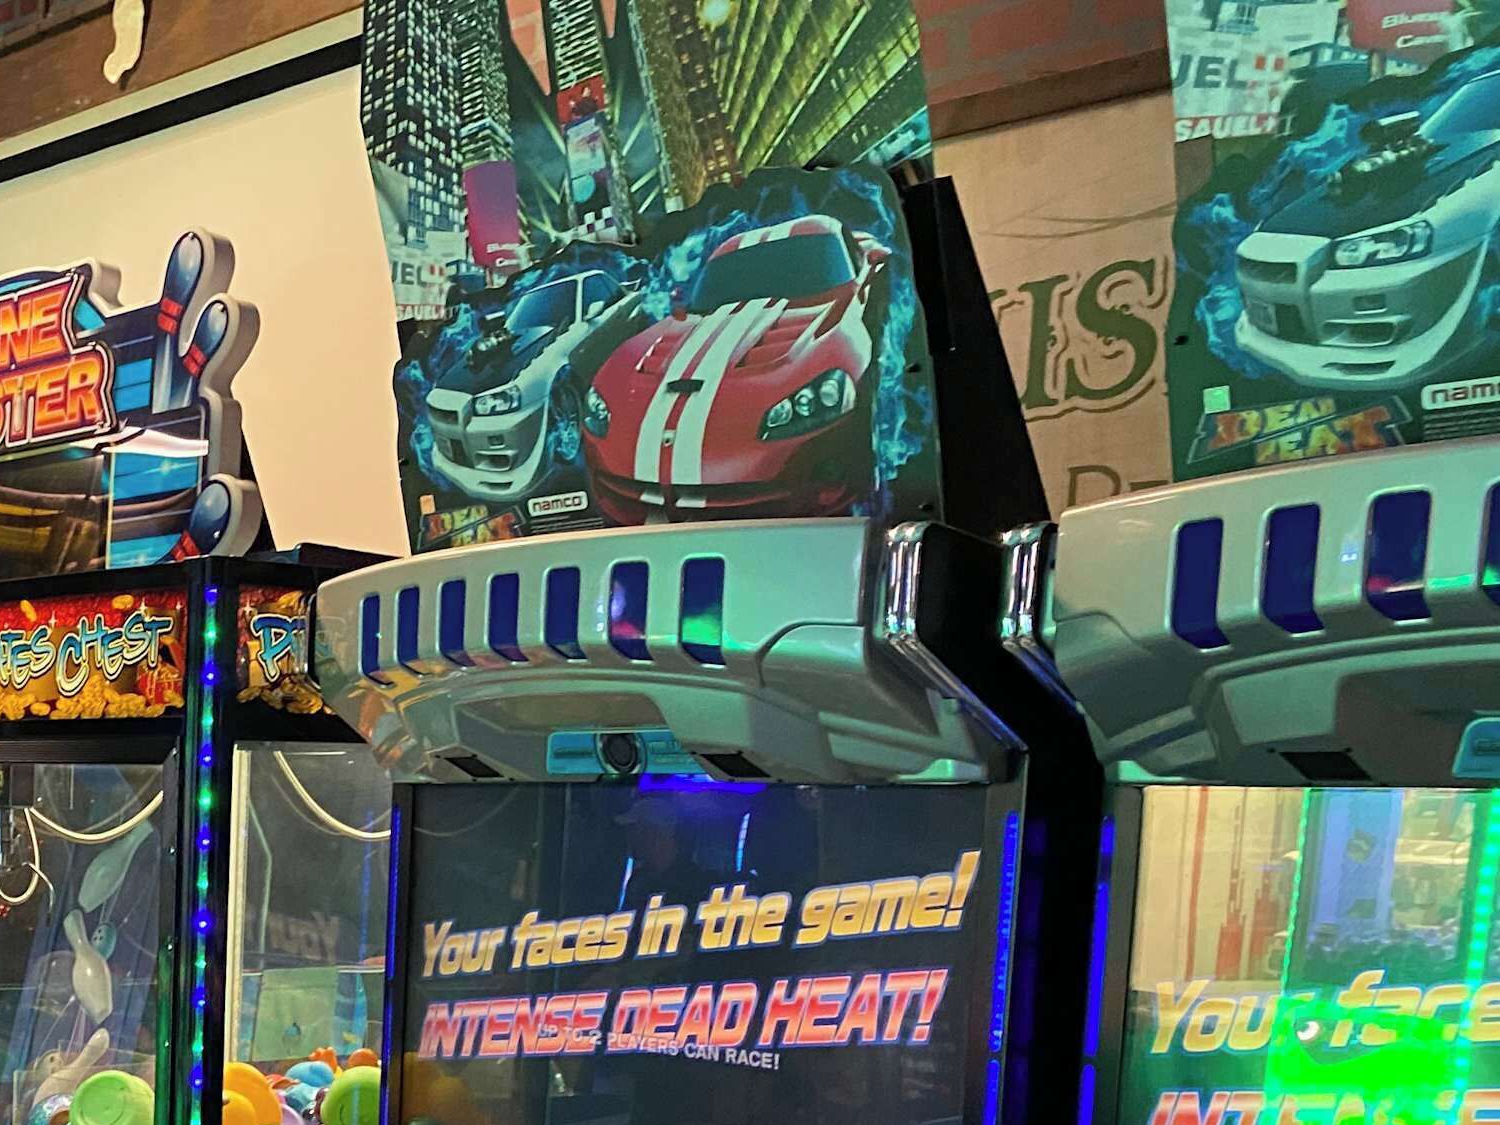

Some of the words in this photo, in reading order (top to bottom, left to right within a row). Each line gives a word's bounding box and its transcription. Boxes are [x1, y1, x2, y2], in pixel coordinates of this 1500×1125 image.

[988, 258, 1158, 410] IS
[1430, 380, 1500, 405] nam
[532, 495, 582, 513] namco
[55, 611, 174, 698] CHEST
[422, 920, 504, 977] Your
[510, 911, 632, 970] faces
[637, 896, 686, 956] in
[696, 885, 790, 951] the
[796, 850, 980, 946] game!
[418, 993, 606, 1059] INTENSE
[607, 982, 758, 1055] DEAD
[759, 969, 950, 1048] HEAT!
[607, 1032, 679, 1056] PLAYERS
[684, 1044, 720, 1063] CAN
[725, 1048, 780, 1070] RACE!
